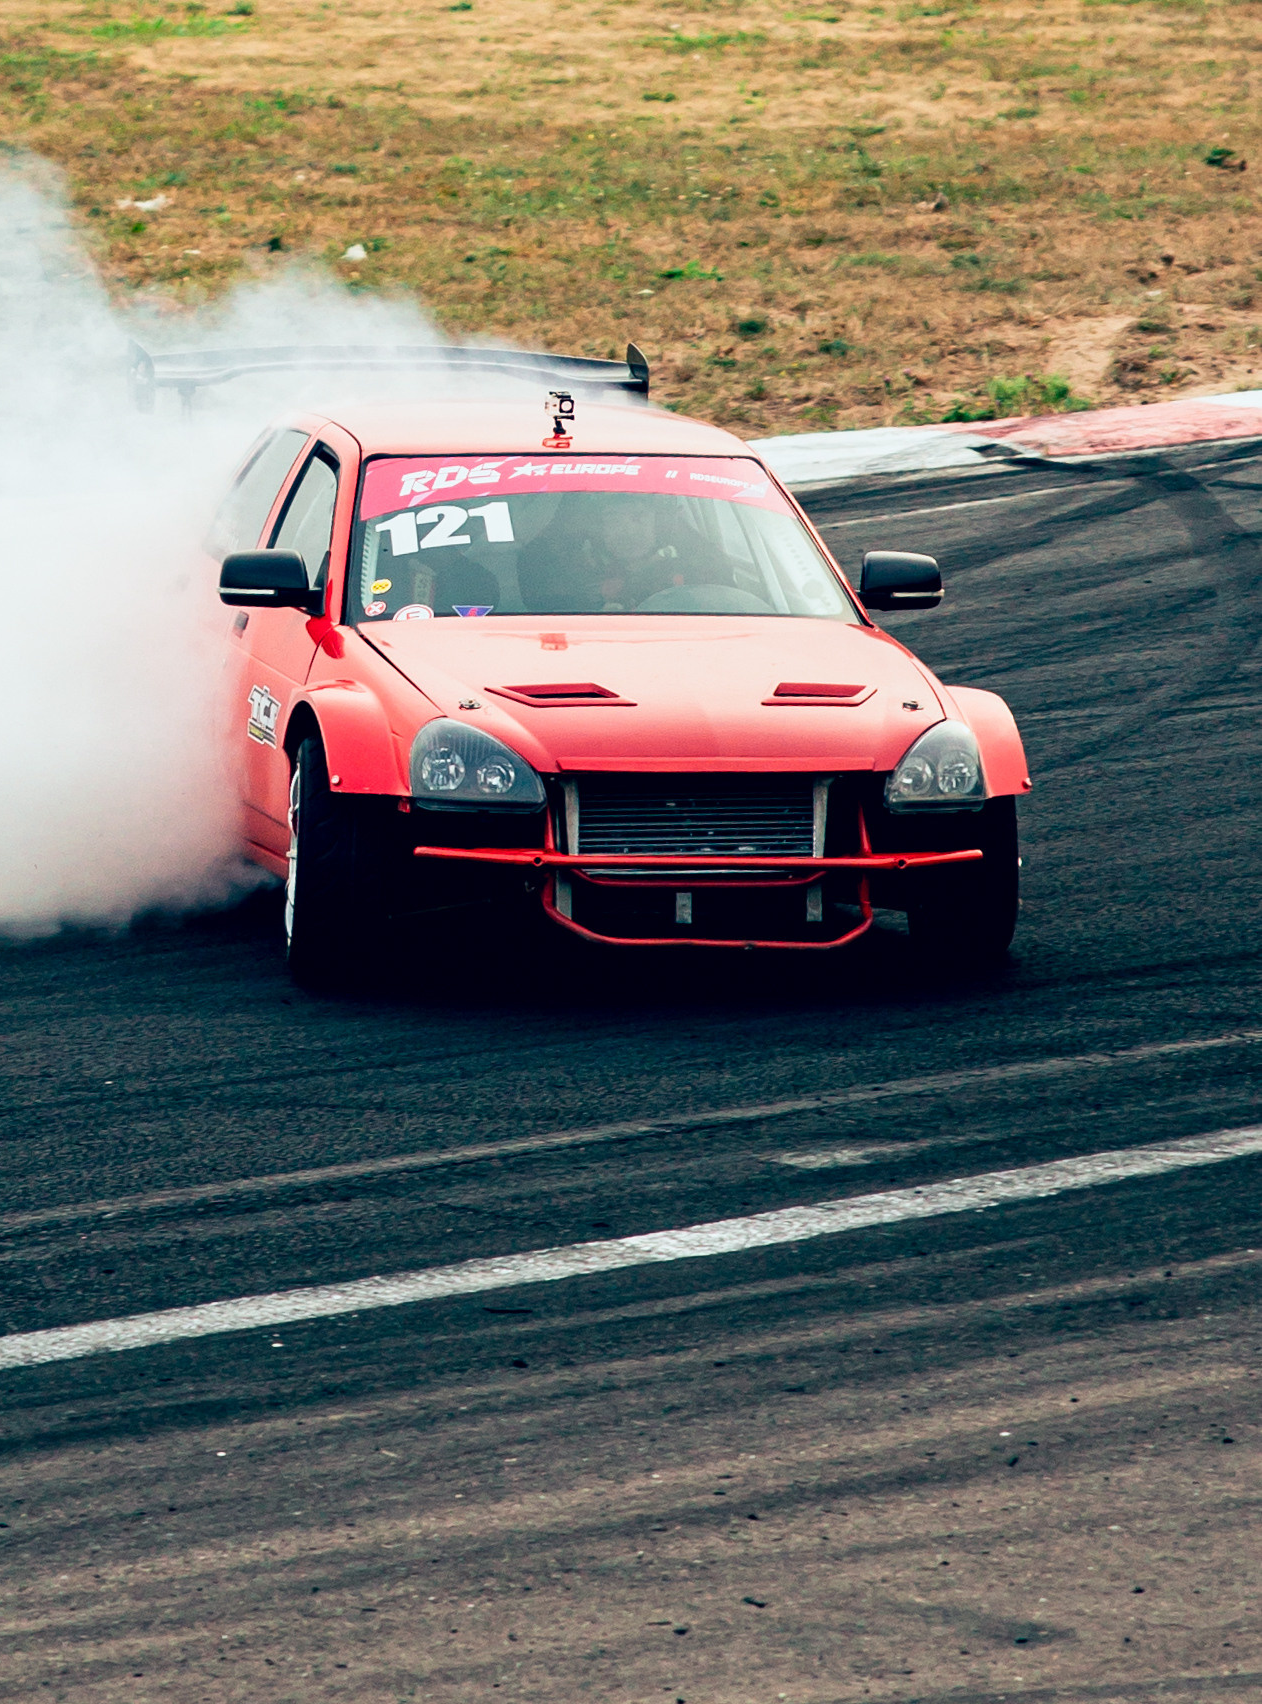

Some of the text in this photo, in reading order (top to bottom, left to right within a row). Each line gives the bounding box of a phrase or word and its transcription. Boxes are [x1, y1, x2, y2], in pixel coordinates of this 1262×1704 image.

[399, 461, 505, 496] RDS
[550, 463, 641, 475] EUROPE
[375, 501, 515, 557] 121
